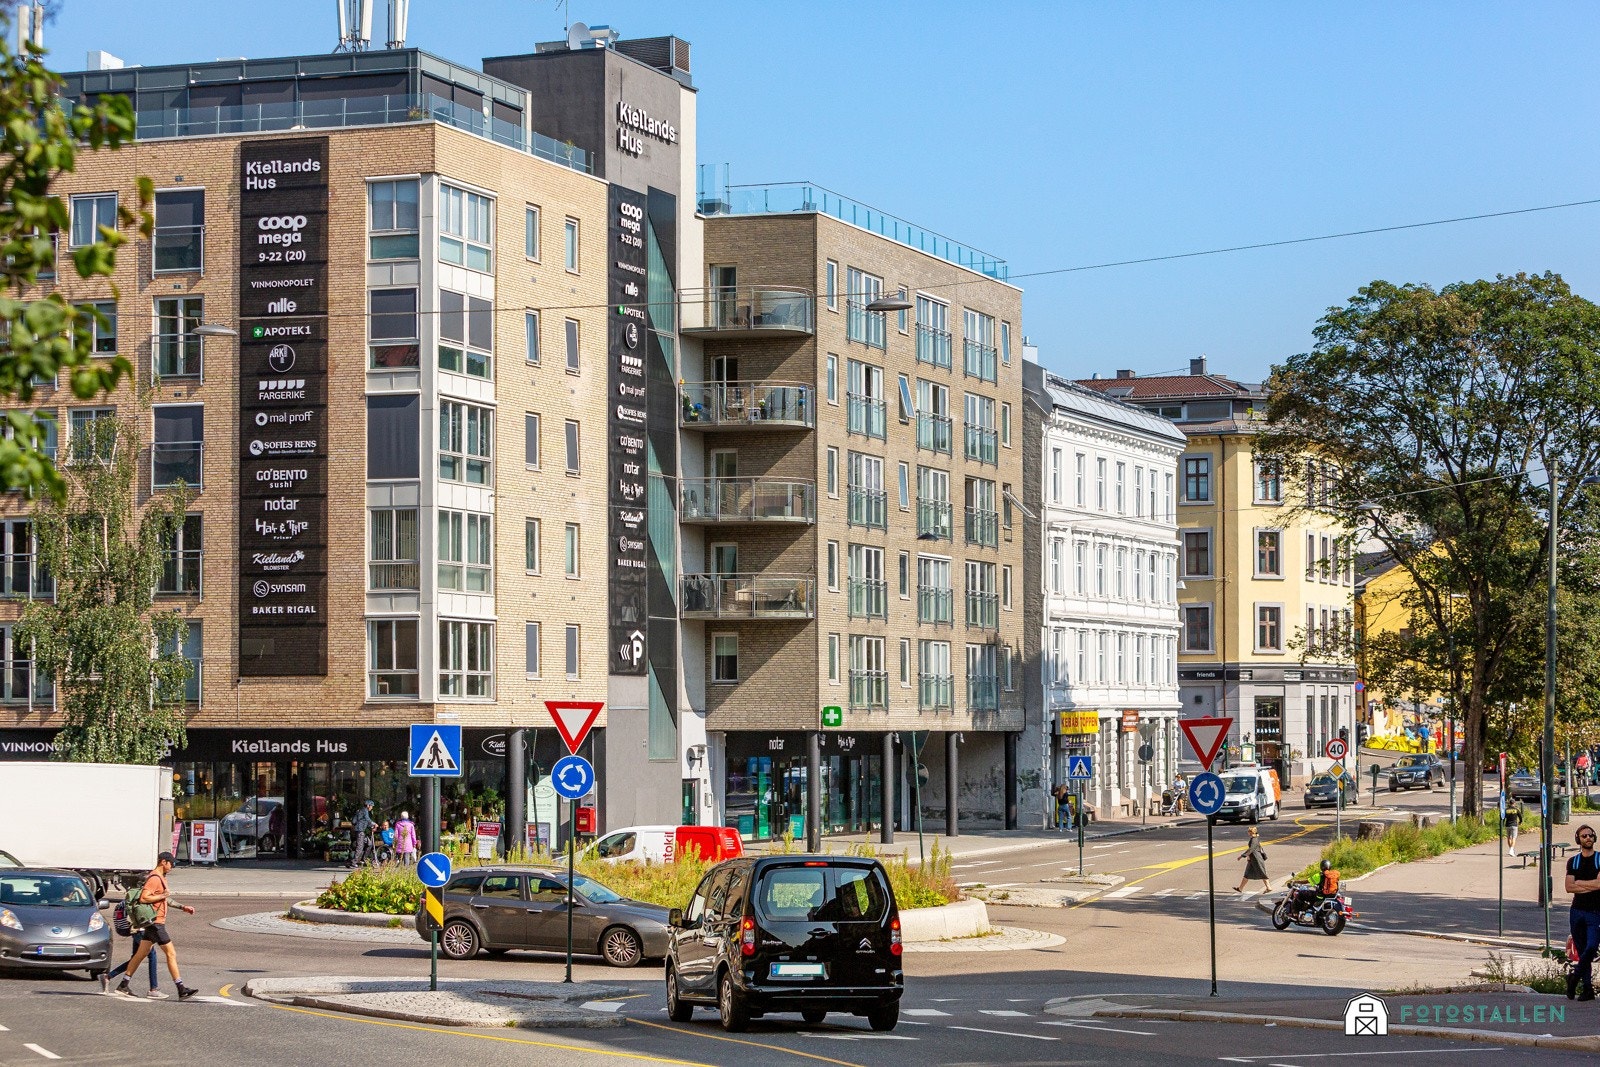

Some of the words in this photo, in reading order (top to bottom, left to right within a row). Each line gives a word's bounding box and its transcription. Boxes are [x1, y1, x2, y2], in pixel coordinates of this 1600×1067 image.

[619, 101, 676, 141] Kiellands
[619, 127, 643, 155] Hus
[246, 159, 321, 175] Kiellands
[246, 177, 277, 190] Hus
[621, 202, 643, 221] coop
[258, 215, 308, 232] coop
[620, 217, 641, 234] mega
[258, 232, 302, 247] mega
[258, 252, 282, 262] 9-22
[285, 249, 306, 262] (20)
[251, 279, 314, 289] VINMONOPOLET
[268, 298, 297, 313] nille
[264, 326, 304, 336] APOTEK
[269, 347, 284, 358] ARK
[258, 389, 306, 401] FARGERIKE
[269, 412, 287, 423] mal
[289, 411, 314, 425] proff
[264, 440, 294, 450] SOFIES
[294, 440, 317, 448] RENS
[623, 461, 640, 475] notar
[264, 497, 299, 511] notar
[252, 552, 299, 565] Kiellands
[252, 606, 284, 614] BAKER
[287, 606, 317, 614] RIGAL
[632, 640, 643, 666] P
[232, 740, 311, 753] Kiellands
[316, 740, 348, 753] Hus
[769, 736, 784, 750] notar
[1329, 744, 1344, 755] 40
